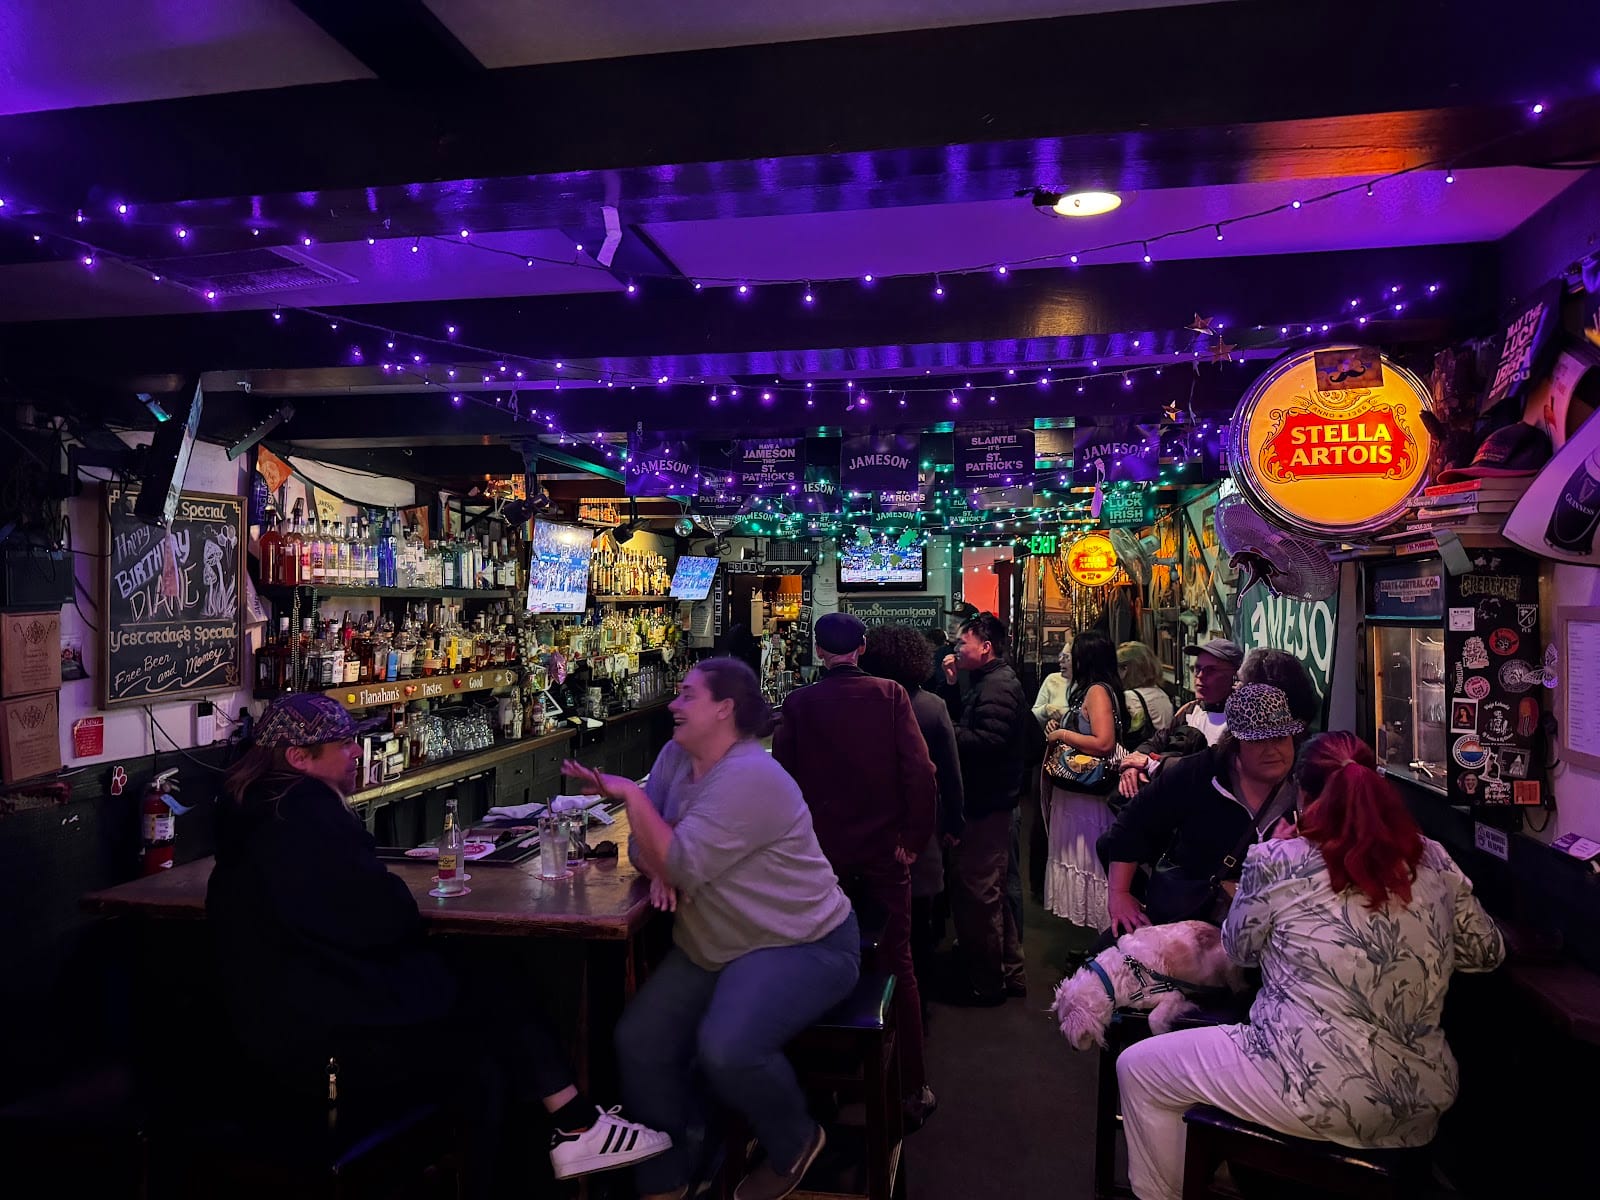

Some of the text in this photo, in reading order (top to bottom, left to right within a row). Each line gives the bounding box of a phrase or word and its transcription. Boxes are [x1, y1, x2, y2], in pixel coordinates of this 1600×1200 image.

[1312, 405, 1336, 419] ANNO
[971, 435, 1018, 446] SLAINTE!
[1291, 423, 1393, 445] STELLA
[743, 448, 796, 459] JAMESON
[986, 453, 1002, 461] ST.
[1083, 442, 1146, 461] JAMESON
[1289, 445, 1394, 467] ARTOIS
[632, 459, 692, 476] JAMESON
[761, 464, 777, 473] ST.
[849, 454, 911, 470] JAMESON
[965, 460, 1024, 472] PATRICK'S
[742, 471, 795, 482] PATRICK'S
[1109, 498, 1143, 508] LUCK
[1565, 492, 1595, 516] GUINNESS
[181, 501, 228, 523] Special
[875, 511, 916, 522] JAMESON
[1109, 510, 1144, 520] IRISH
[1031, 535, 1057, 554] EXIT
[129, 562, 200, 624] DIANE
[110, 622, 240, 654] Yesterday's Special
[114, 653, 172, 692] Free Beer
[157, 646, 226, 684] and Money
[359, 676, 484, 705] Flanahan's Tastes Good
